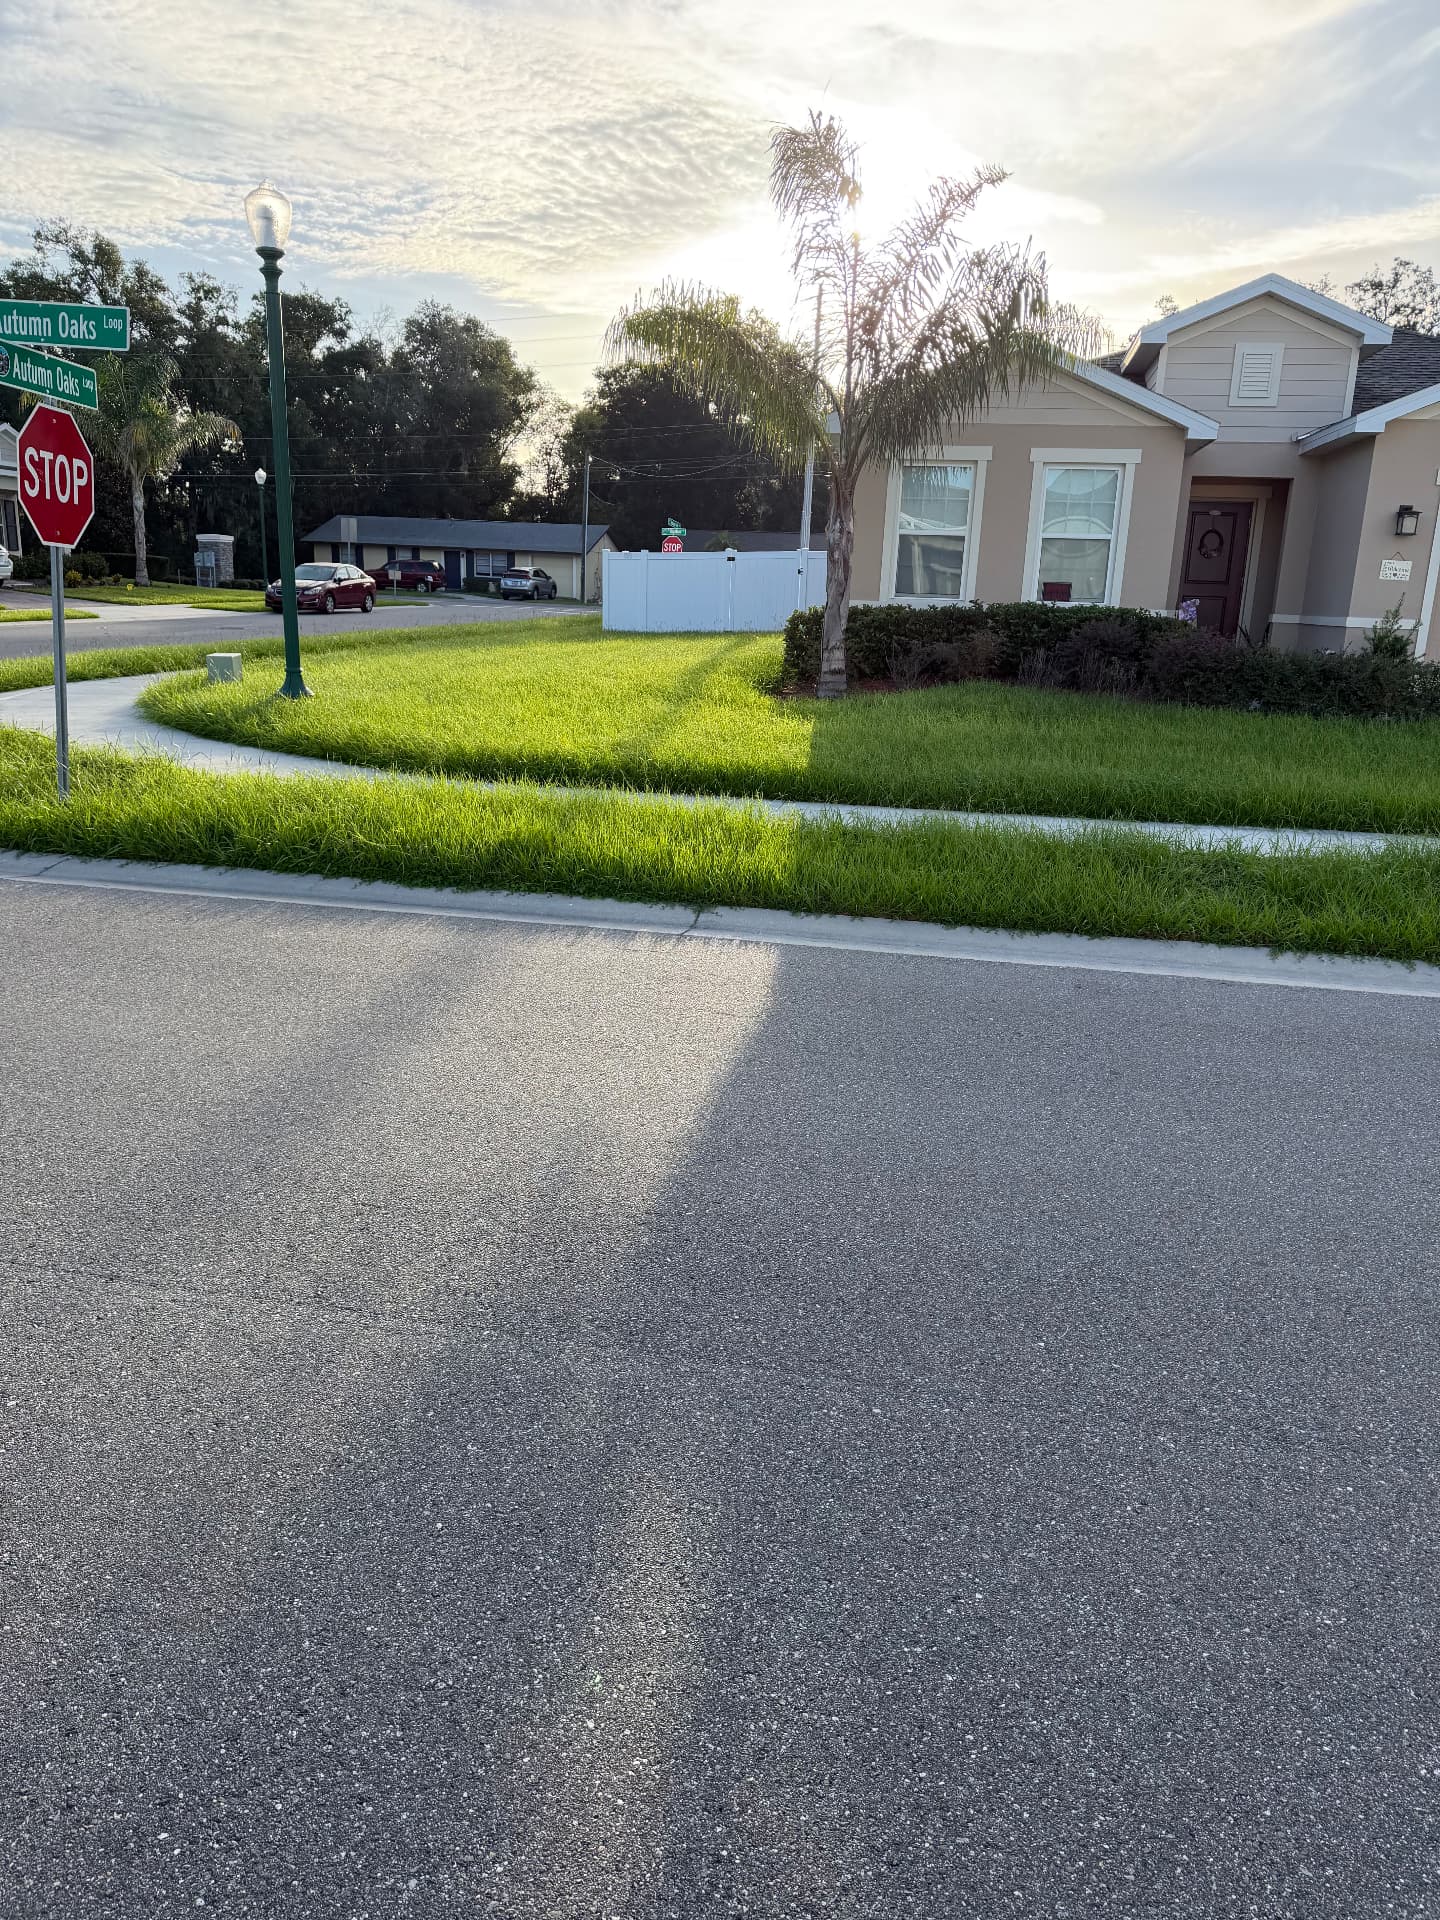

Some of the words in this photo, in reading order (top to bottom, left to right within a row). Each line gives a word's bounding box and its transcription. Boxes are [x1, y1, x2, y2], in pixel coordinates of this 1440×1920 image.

[58, 311, 97, 340] Oaks
[103, 315, 123, 332] Loop
[13, 353, 53, 389] Autumn
[56, 366, 80, 397] Oaks
[82, 375, 94, 393] Loop
[23, 446, 89, 505] STOP
[663, 542, 682, 552] STOP
